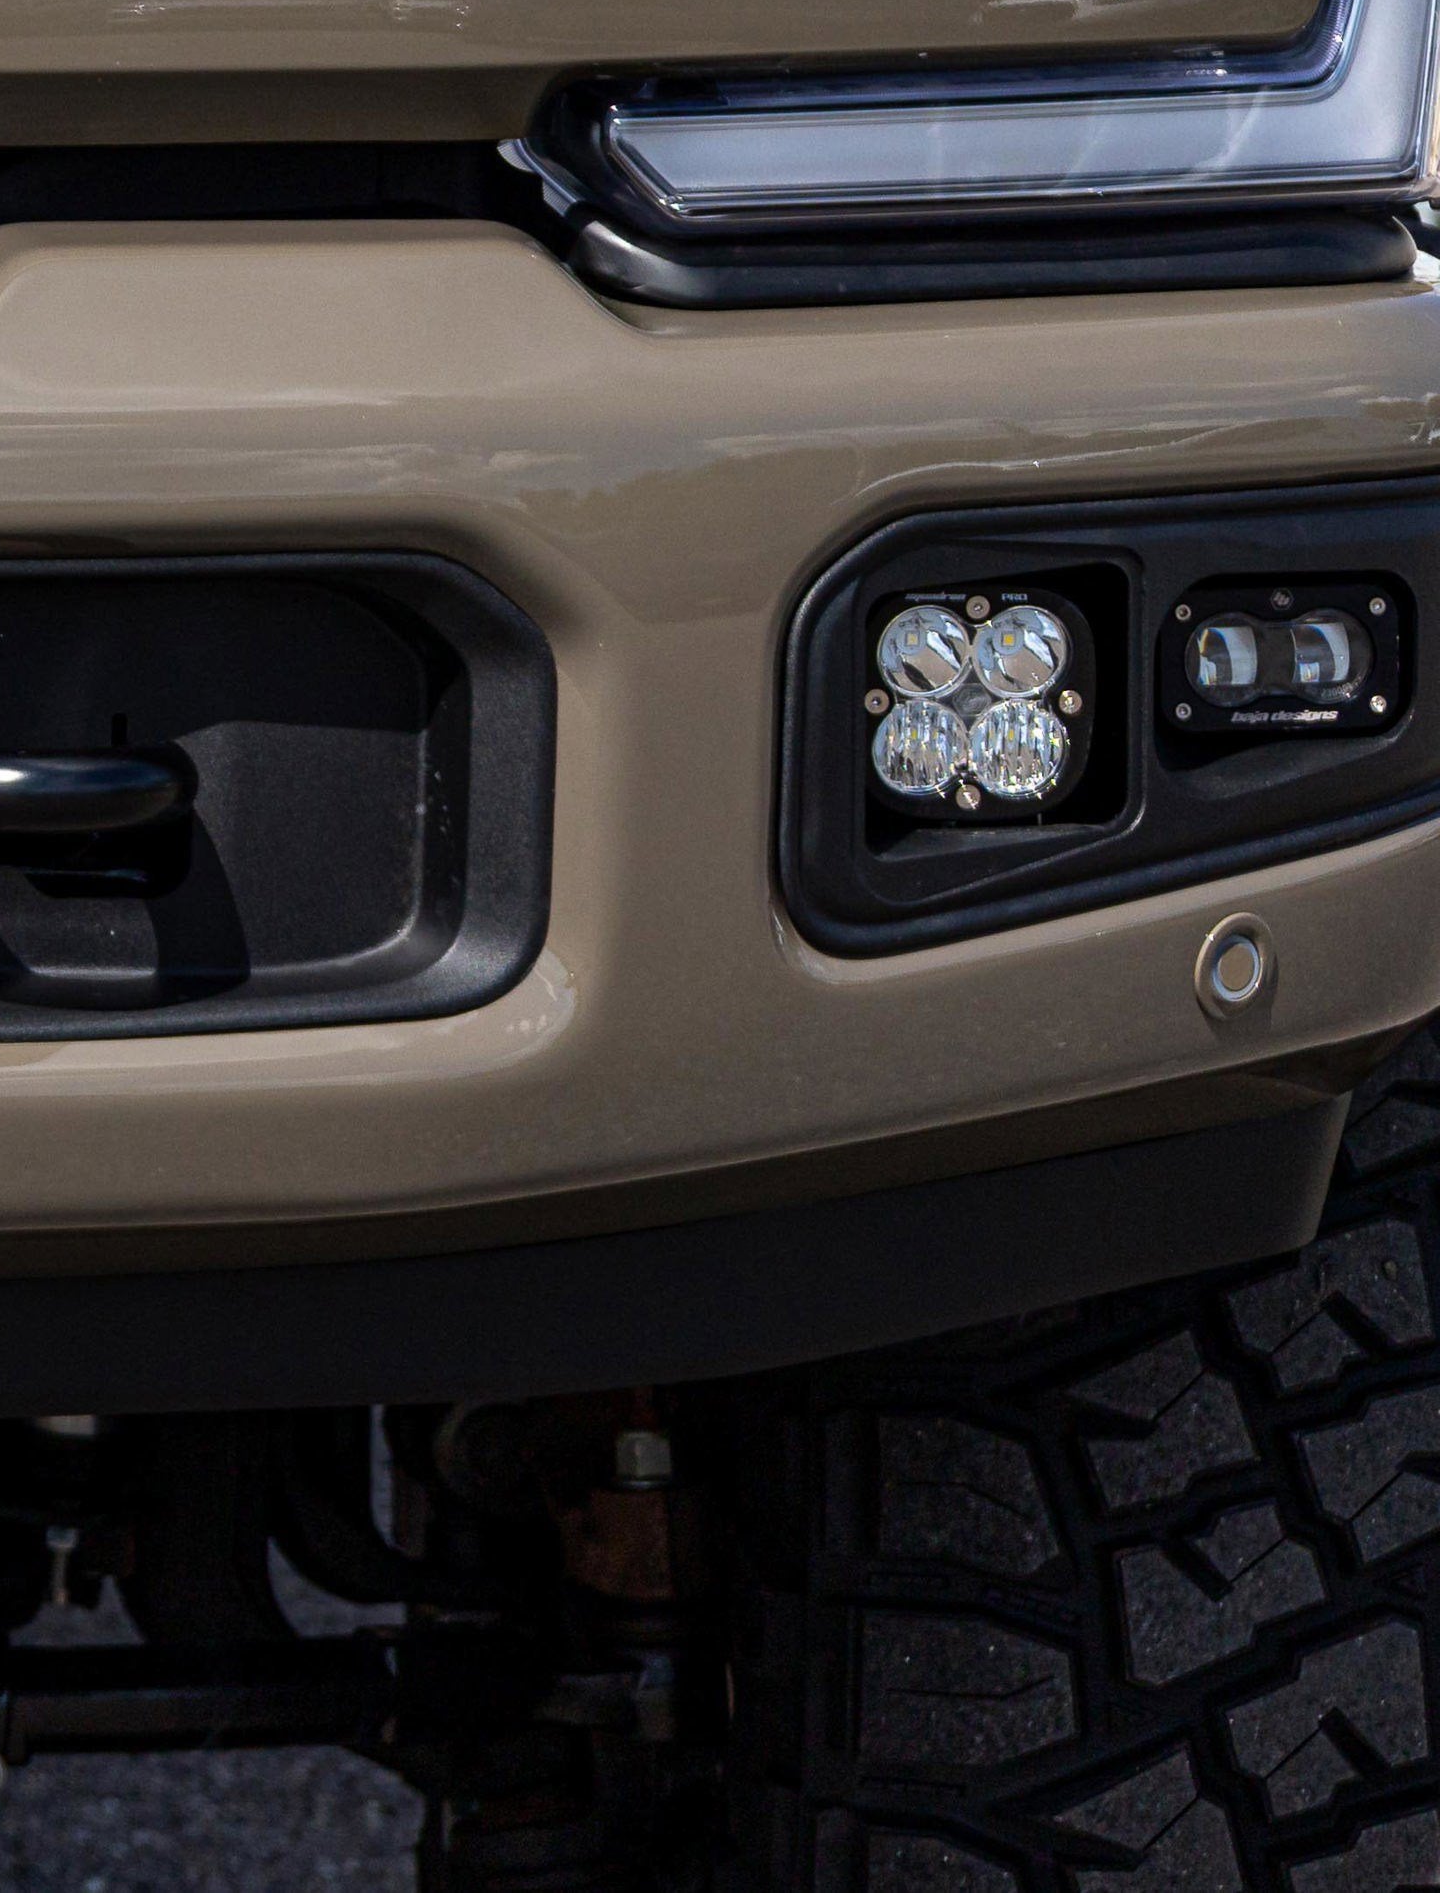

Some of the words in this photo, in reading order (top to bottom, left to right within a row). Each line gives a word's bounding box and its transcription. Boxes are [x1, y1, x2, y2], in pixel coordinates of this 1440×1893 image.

[1001, 592, 1028, 602] PRO
[1231, 710, 1269, 724] baja
[1270, 709, 1339, 722] designs
